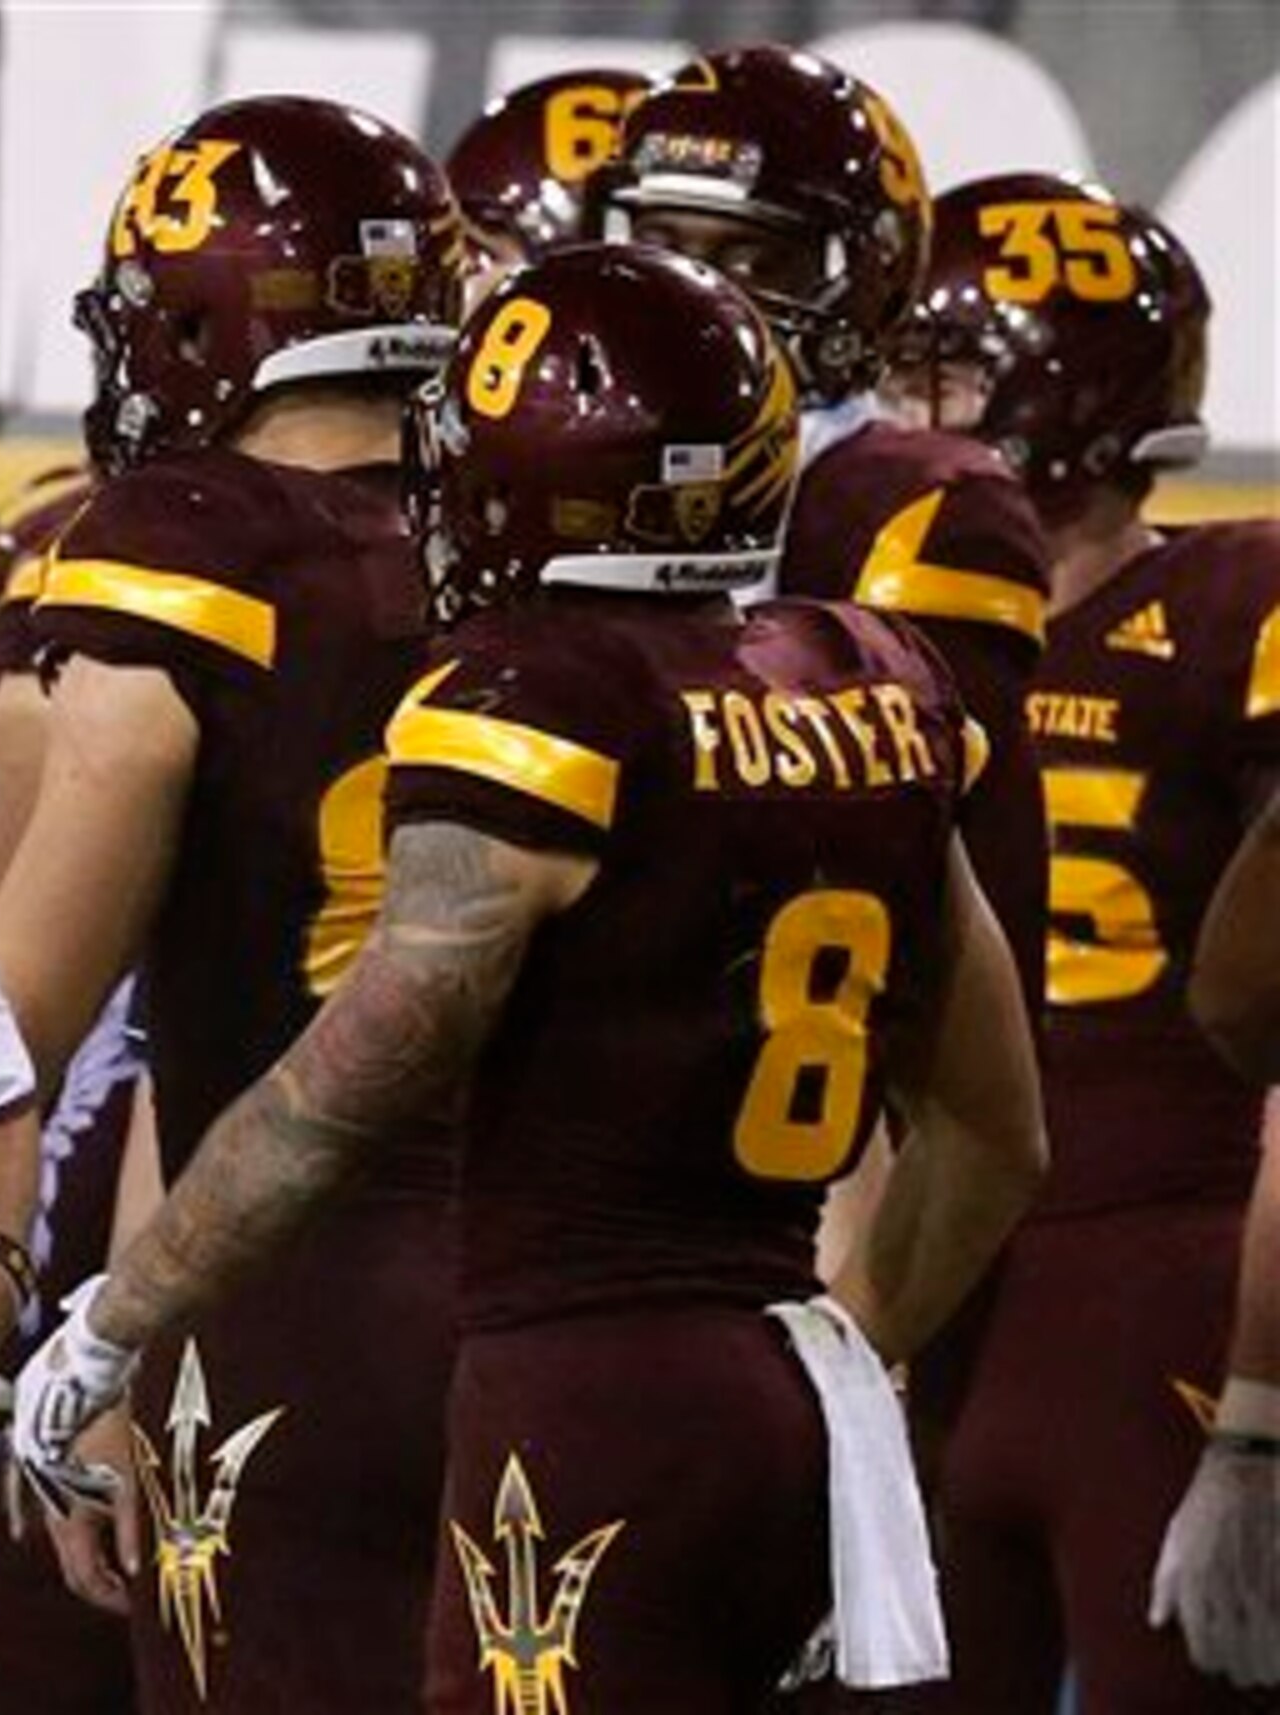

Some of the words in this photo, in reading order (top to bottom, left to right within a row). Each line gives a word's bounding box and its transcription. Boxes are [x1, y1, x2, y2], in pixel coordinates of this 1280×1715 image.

[545, 86, 645, 181] 6
[979, 202, 1135, 303] 35
[466, 297, 551, 419] 8
[681, 683, 934, 790] FOSTER
[1024, 692, 1119, 743] STATE
[1040, 768, 1169, 1005] 5
[733, 888, 893, 1182] 8
